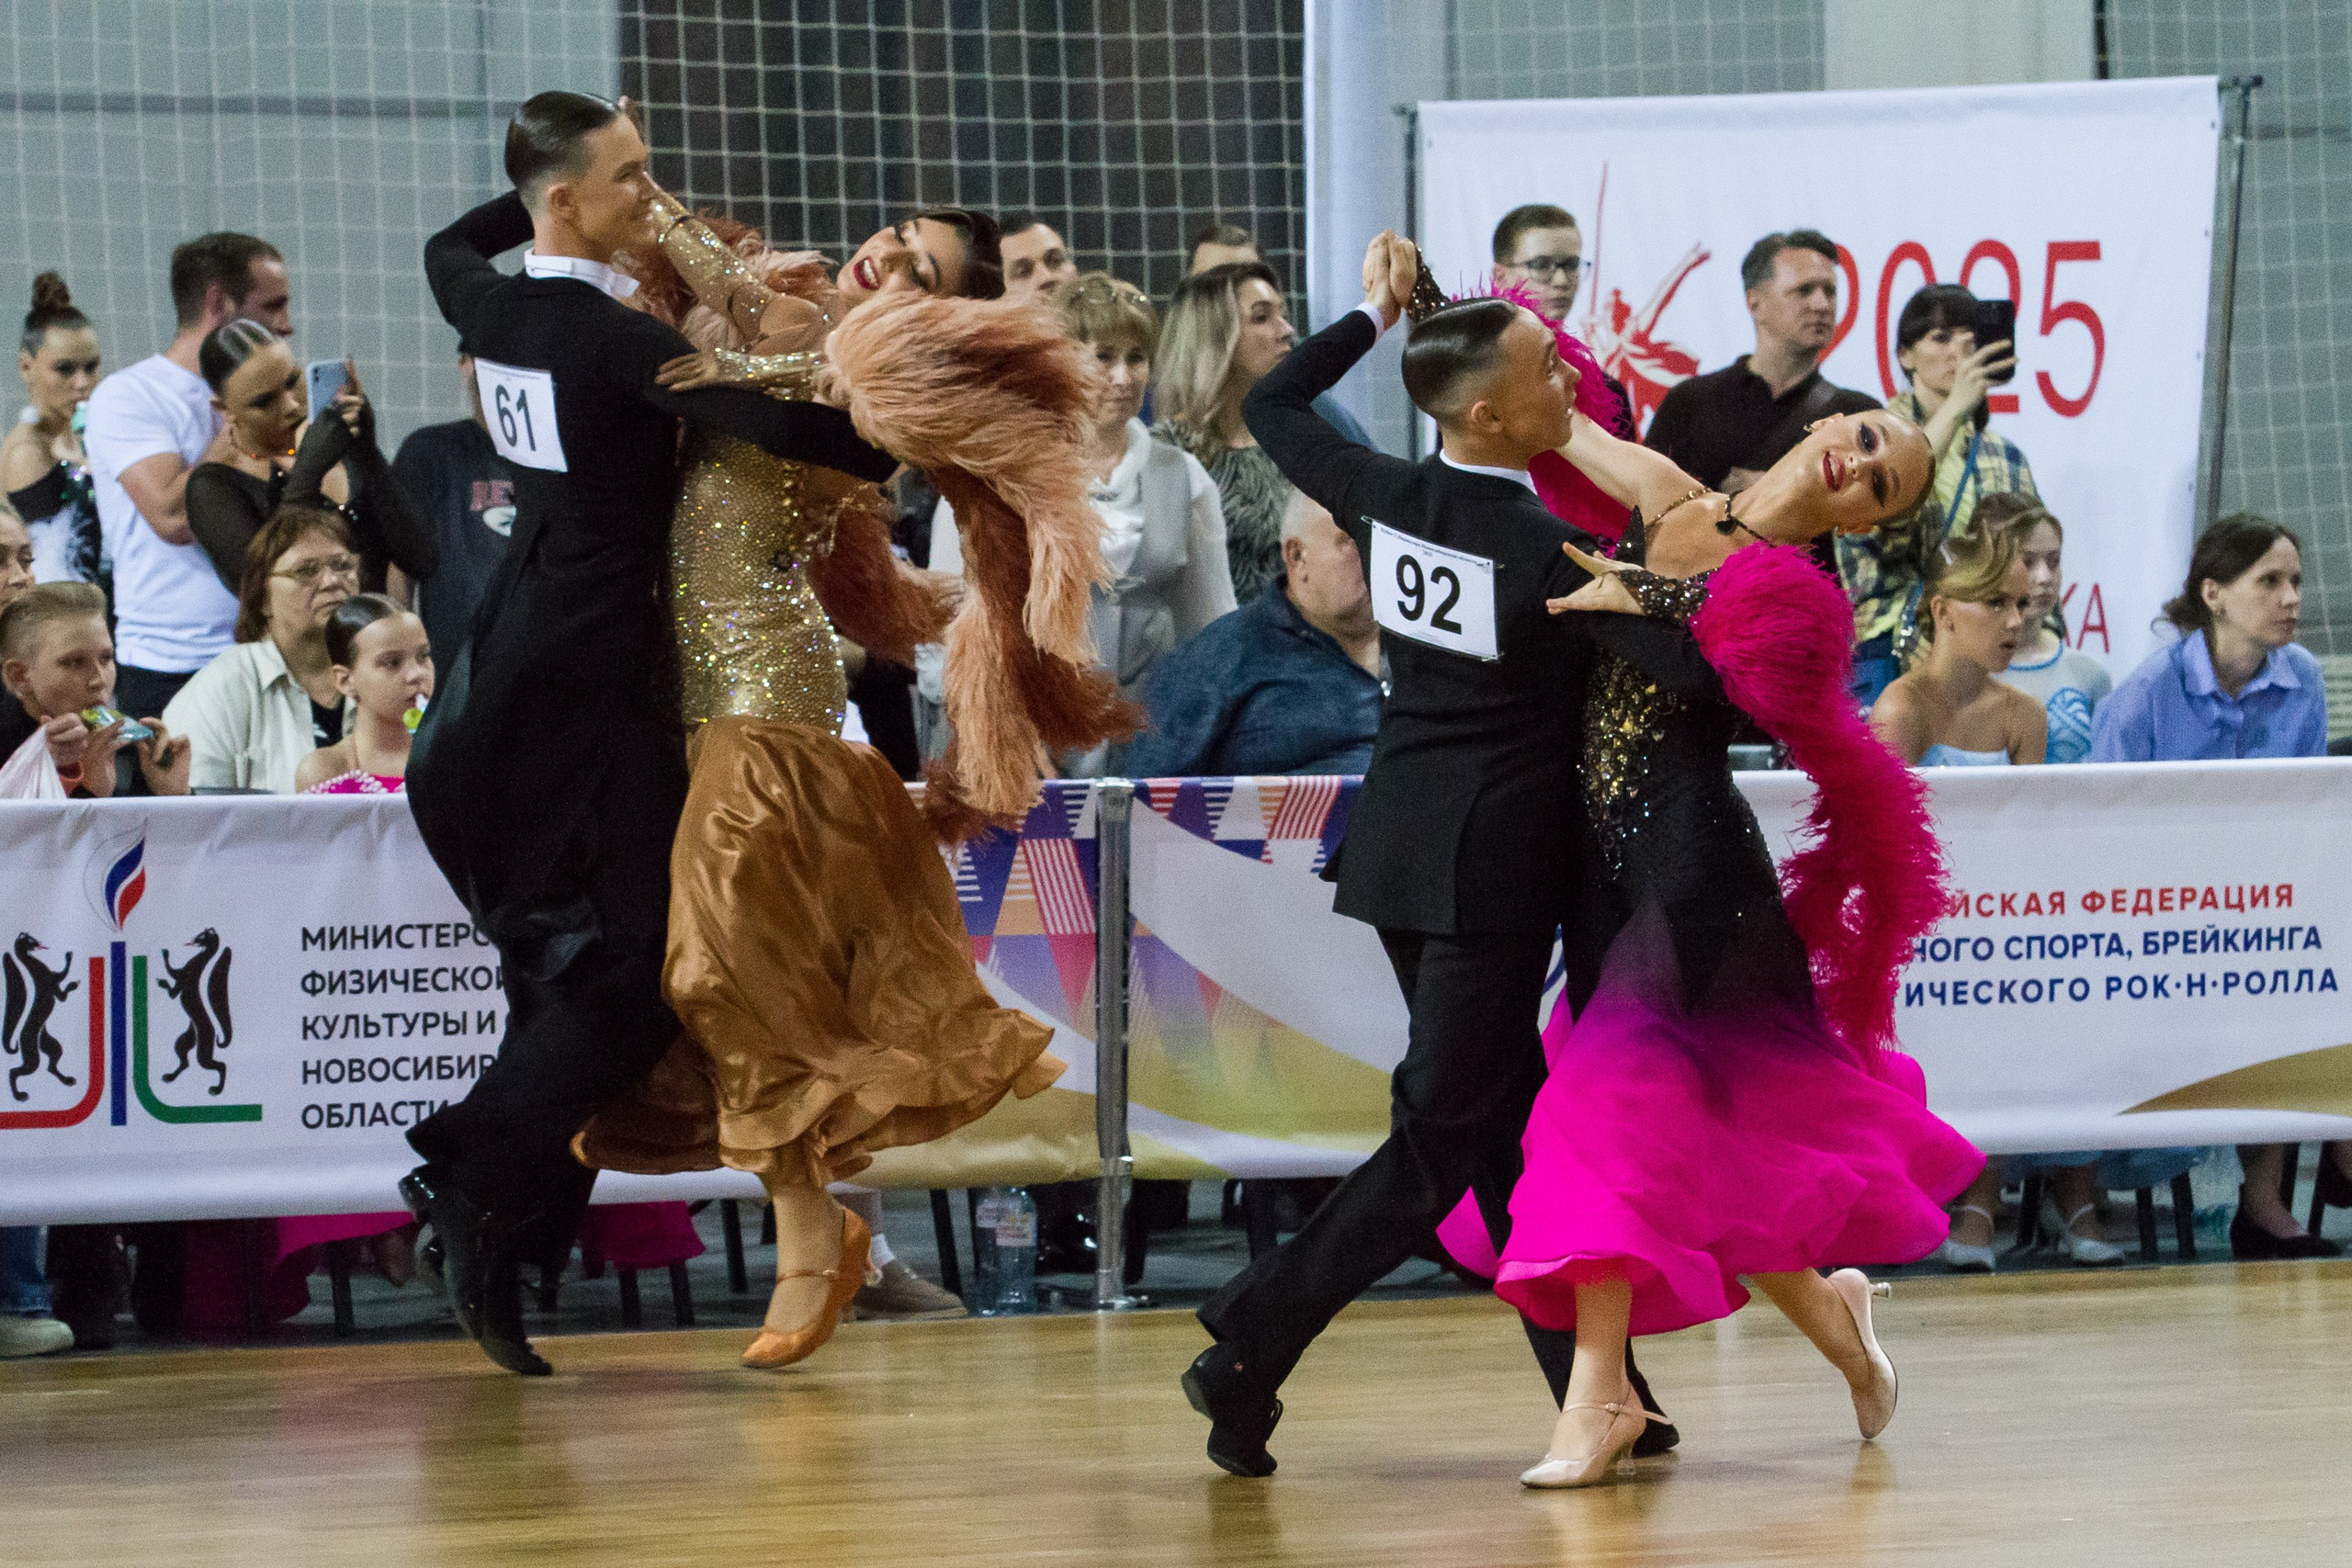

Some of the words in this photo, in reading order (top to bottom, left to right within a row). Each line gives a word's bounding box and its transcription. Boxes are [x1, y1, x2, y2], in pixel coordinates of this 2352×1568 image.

[495, 384, 536, 452] 61
[1396, 554, 1462, 635] 92
[2081, 883, 2294, 917] ФЕДЕРАЦИЯ
[2004, 931, 2133, 961] СПОРТА,
[2143, 925, 2323, 957] БРЕЙКИНГА
[1905, 976, 2091, 1008] ИЧЕСКОГО
[301, 1011, 468, 1042] КУЛЬТУРЫ
[476, 1010, 497, 1036] И
